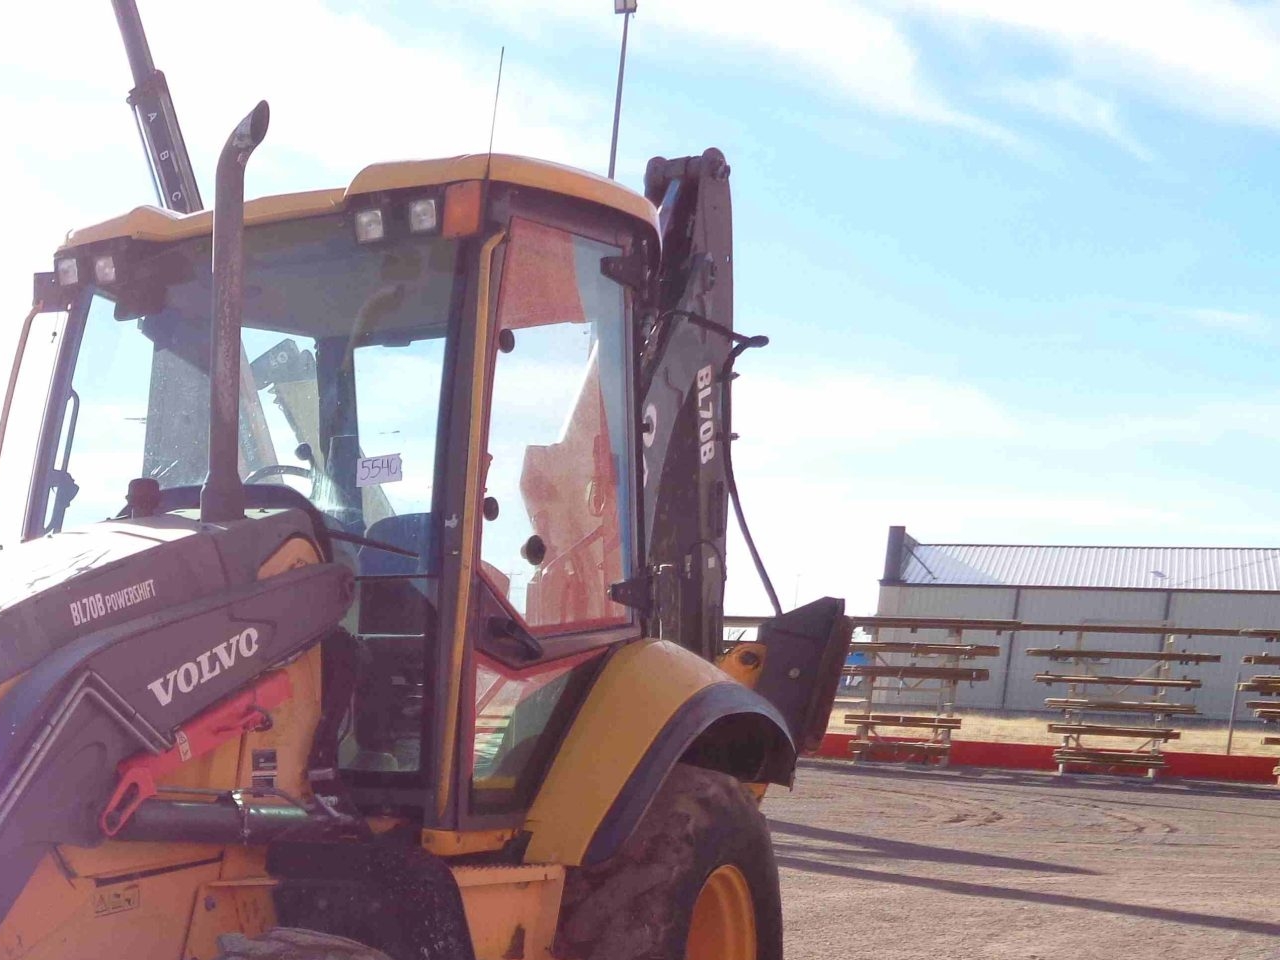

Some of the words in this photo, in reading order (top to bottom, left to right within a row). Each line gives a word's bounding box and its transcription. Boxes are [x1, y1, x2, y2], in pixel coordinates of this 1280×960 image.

[696, 365, 715, 464] BL70B
[360, 457, 398, 481] 5540
[69, 592, 106, 626] BL70B
[104, 579, 156, 613] POWERSHIFT
[146, 626, 259, 707] VOLVO
